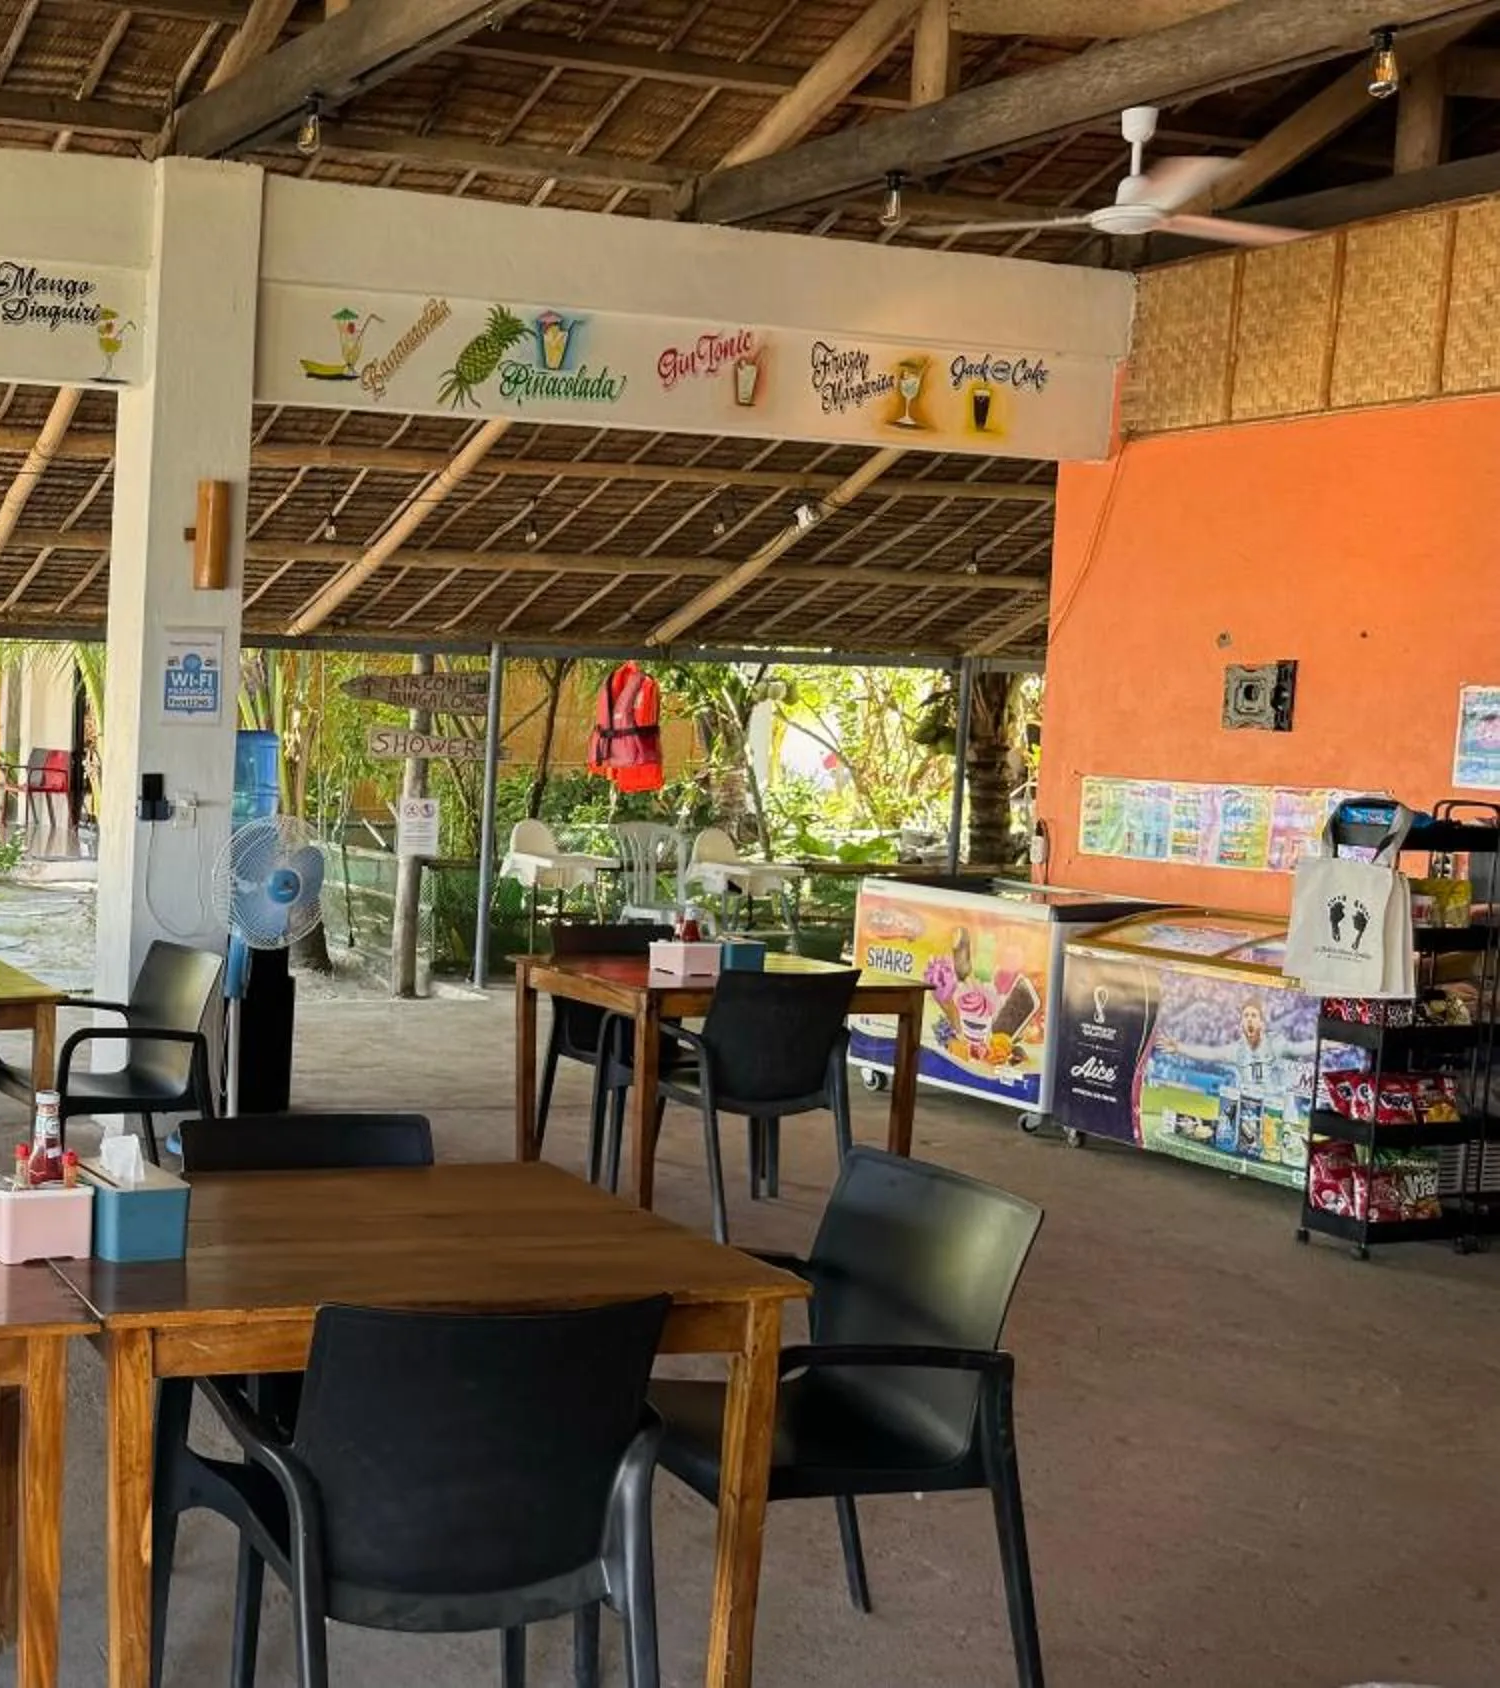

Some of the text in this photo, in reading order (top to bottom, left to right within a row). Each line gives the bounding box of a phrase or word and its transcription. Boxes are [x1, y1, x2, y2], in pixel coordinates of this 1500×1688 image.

[950, 353, 991, 390] Jack
[1011, 358, 1049, 394] Coke
[371, 732, 478, 758] SHOWER
